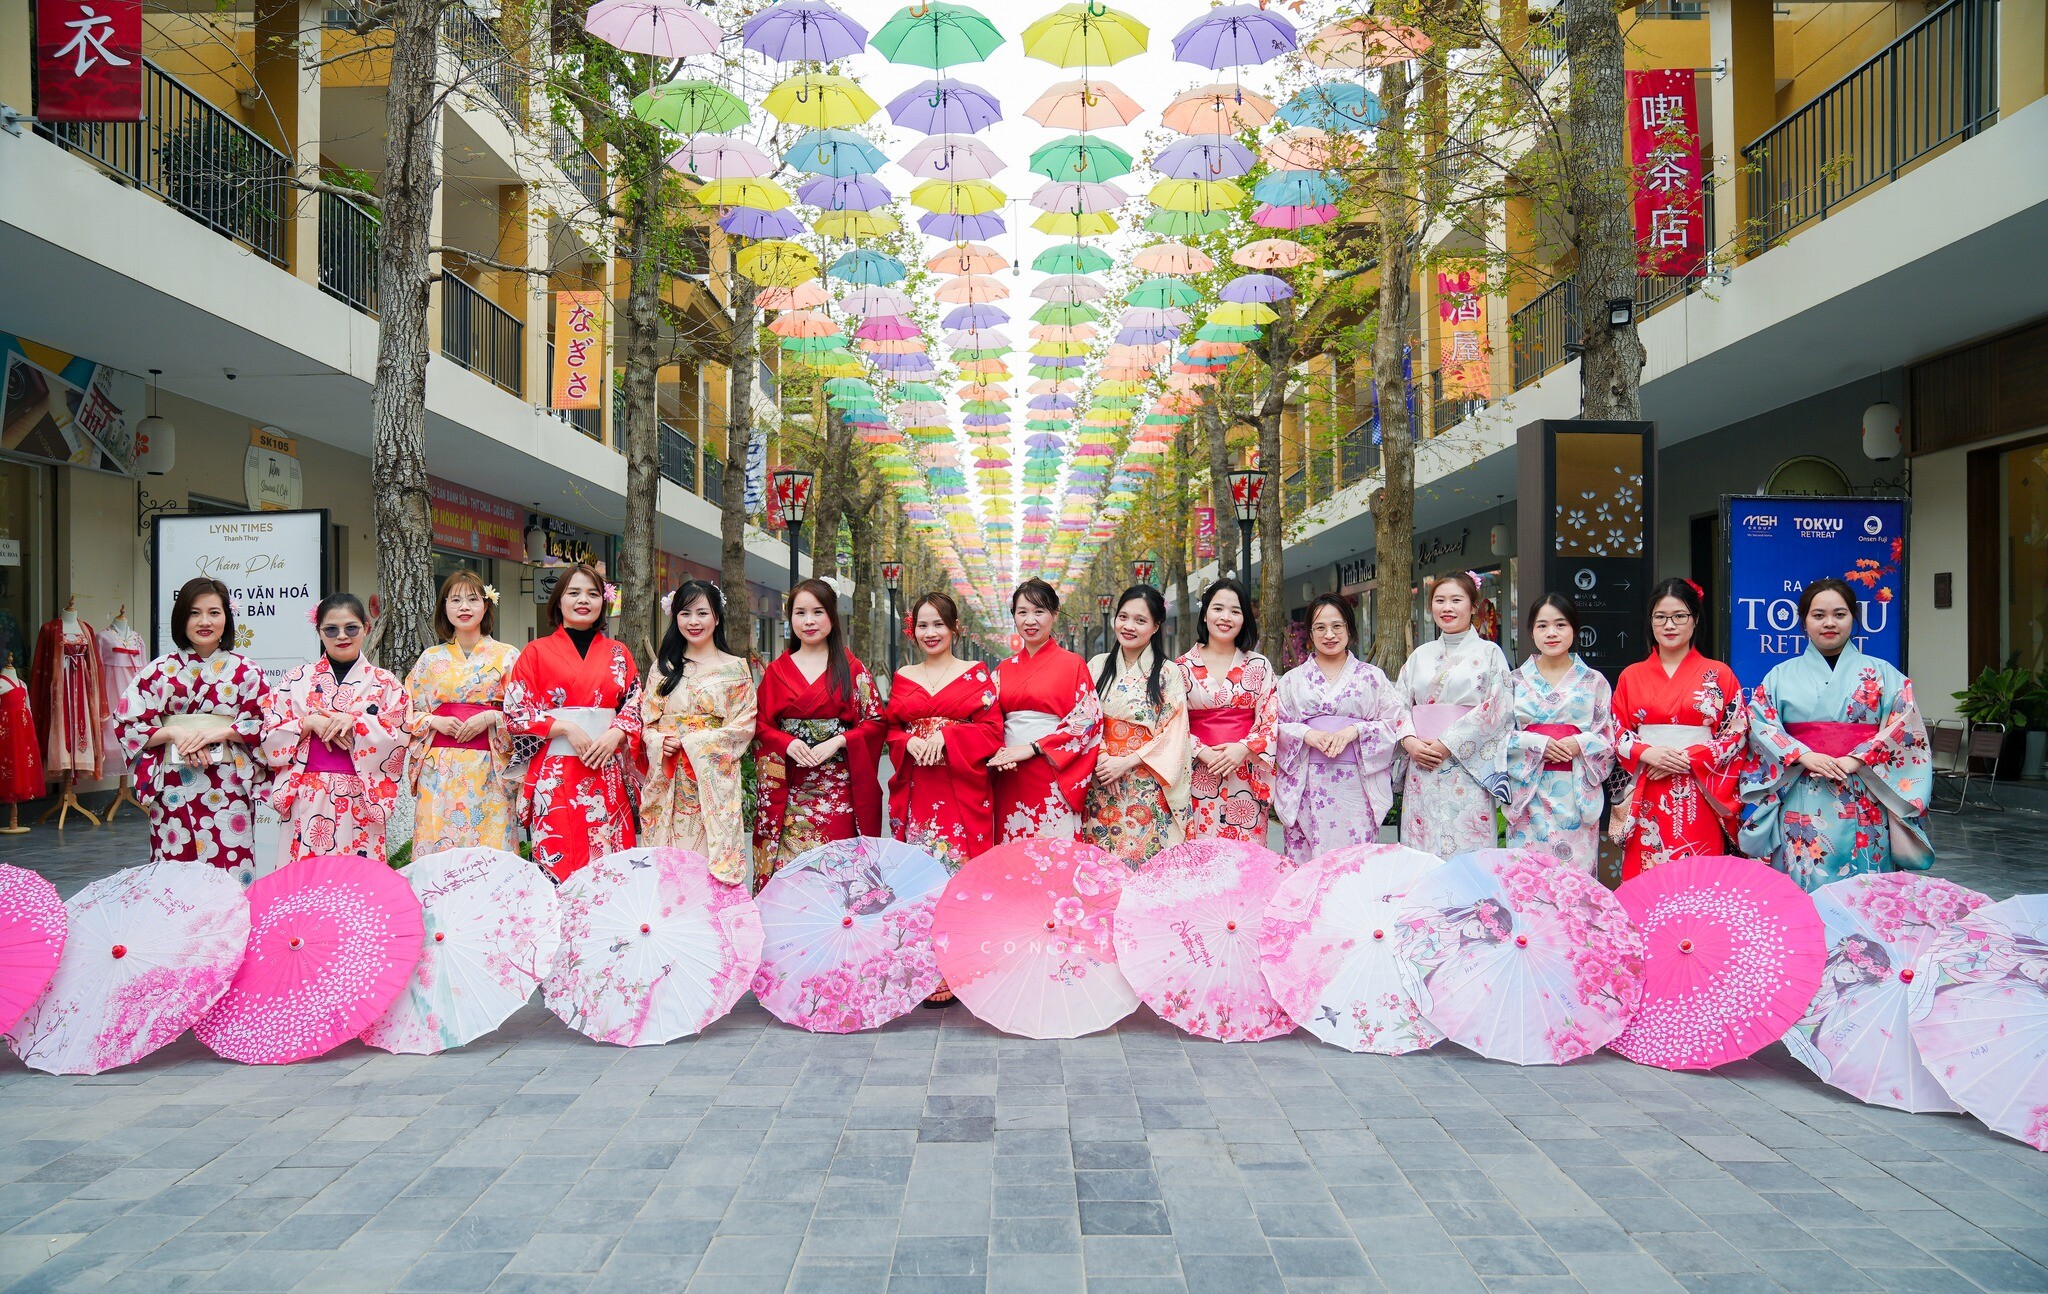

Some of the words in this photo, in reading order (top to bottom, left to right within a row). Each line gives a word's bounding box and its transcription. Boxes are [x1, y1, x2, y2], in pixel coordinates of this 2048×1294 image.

[53, 5, 131, 77] 衣
[566, 304, 595, 400] なぎさ
[260, 435, 289, 452] SK105
[210, 524, 238, 534] LYNN
[241, 523, 273, 532] TIMES
[1743, 515, 1778, 526] MSH
[1794, 518, 1844, 531] TOKYU
[549, 531, 563, 558] Tea
[196, 554, 240, 580] Khám
[246, 554, 286, 578] Phá
[247, 585, 274, 599] VĂN
[279, 583, 309, 598] HOÁ
[1784, 580, 1803, 592] RA
[248, 603, 275, 616] BẢN
[1738, 598, 1890, 634] TOU
